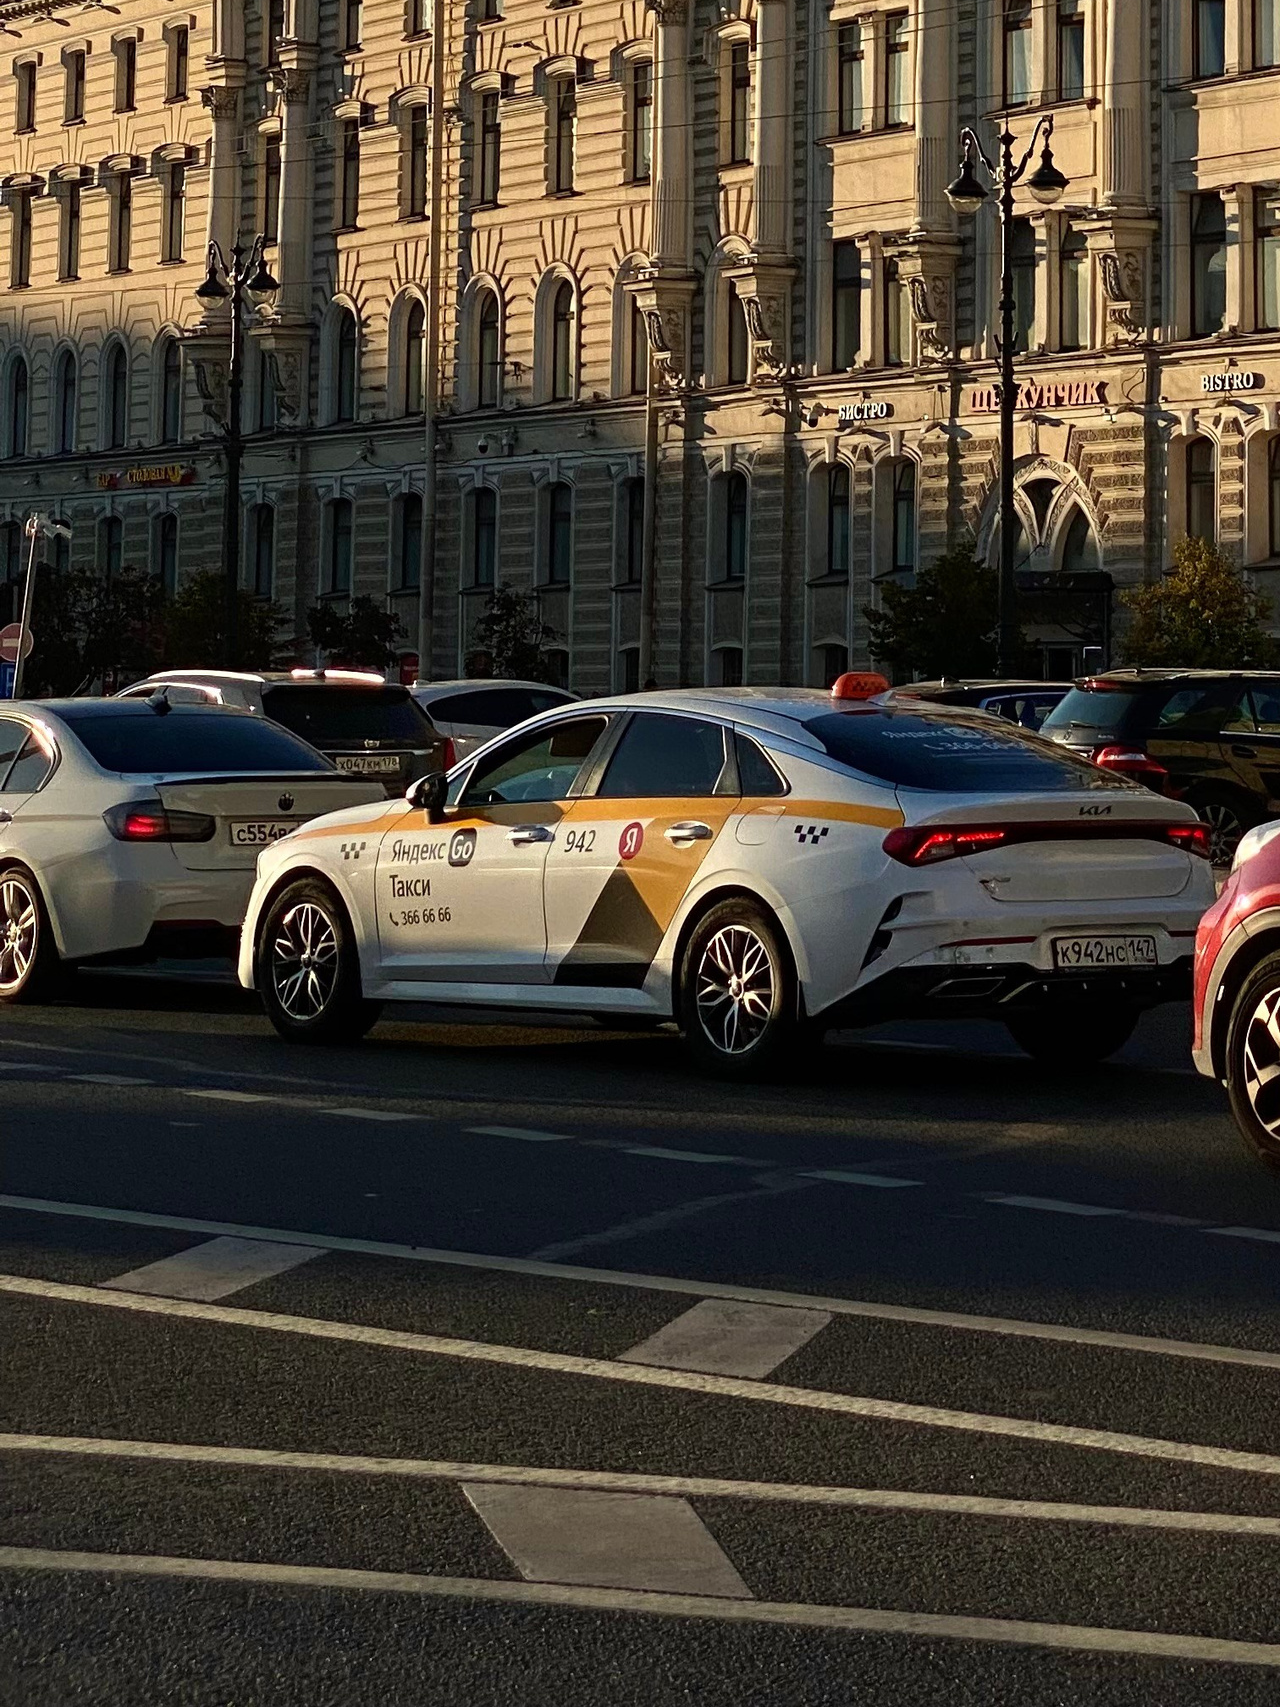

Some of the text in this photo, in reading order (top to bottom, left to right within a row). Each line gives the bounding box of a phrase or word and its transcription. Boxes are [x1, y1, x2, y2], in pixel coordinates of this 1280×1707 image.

[1201, 371, 1254, 392] BISTRO
[969, 380, 1101, 413] ЩЕКУНЧИК
[838, 402, 888, 421] БИСТРО
[391, 835, 473, 865] Яндекс Go
[564, 830, 597, 853] 942
[389, 874, 431, 898] Такси
[401, 906, 452, 926] 366 66 66
